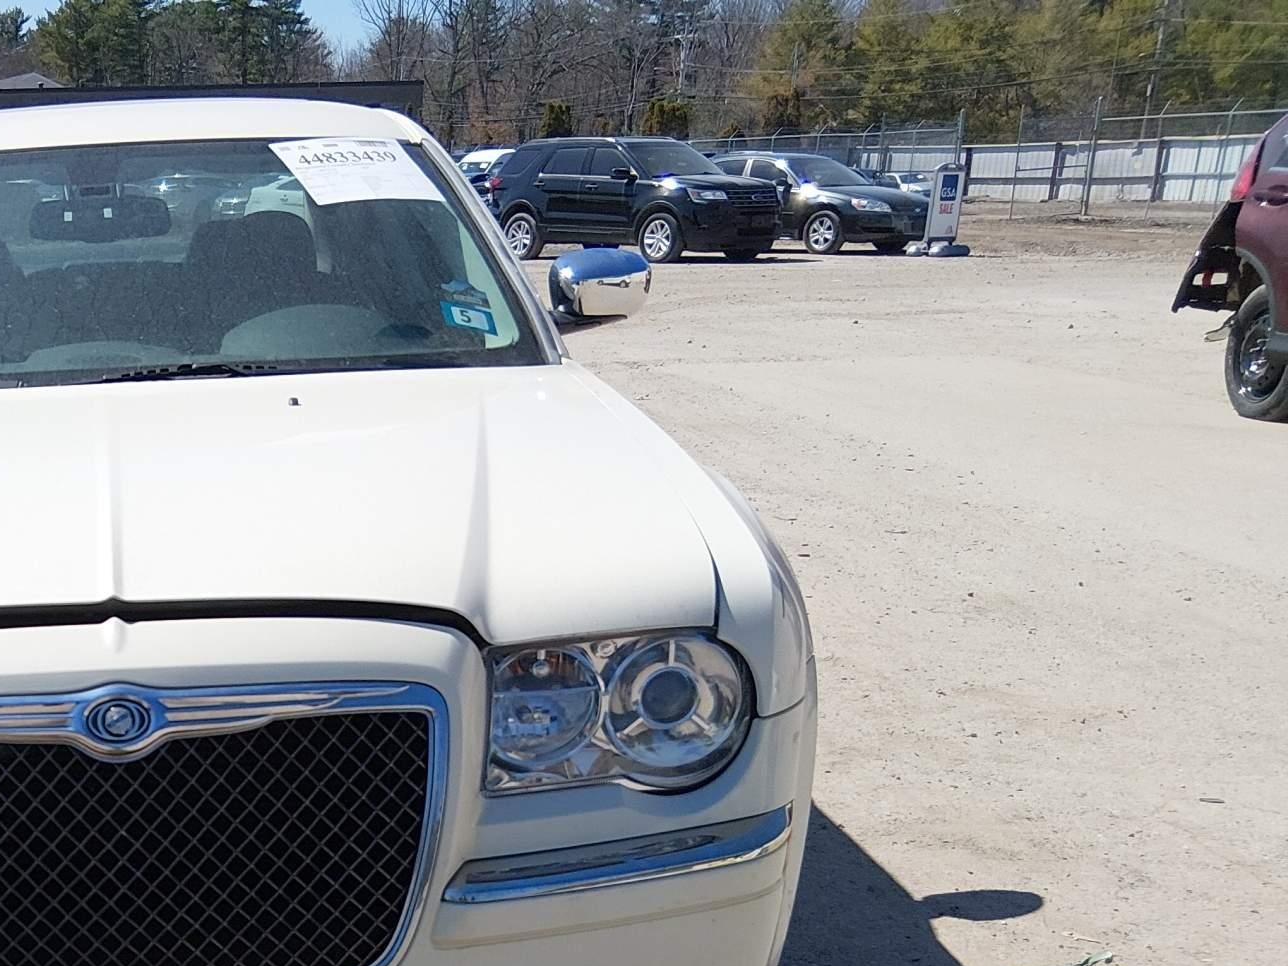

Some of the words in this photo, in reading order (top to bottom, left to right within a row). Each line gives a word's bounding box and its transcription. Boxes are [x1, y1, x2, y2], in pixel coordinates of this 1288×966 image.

[298, 150, 398, 166] 44833439
[941, 187, 956, 198] GSA
[939, 203, 954, 215] SALE
[459, 309, 472, 324] 5
